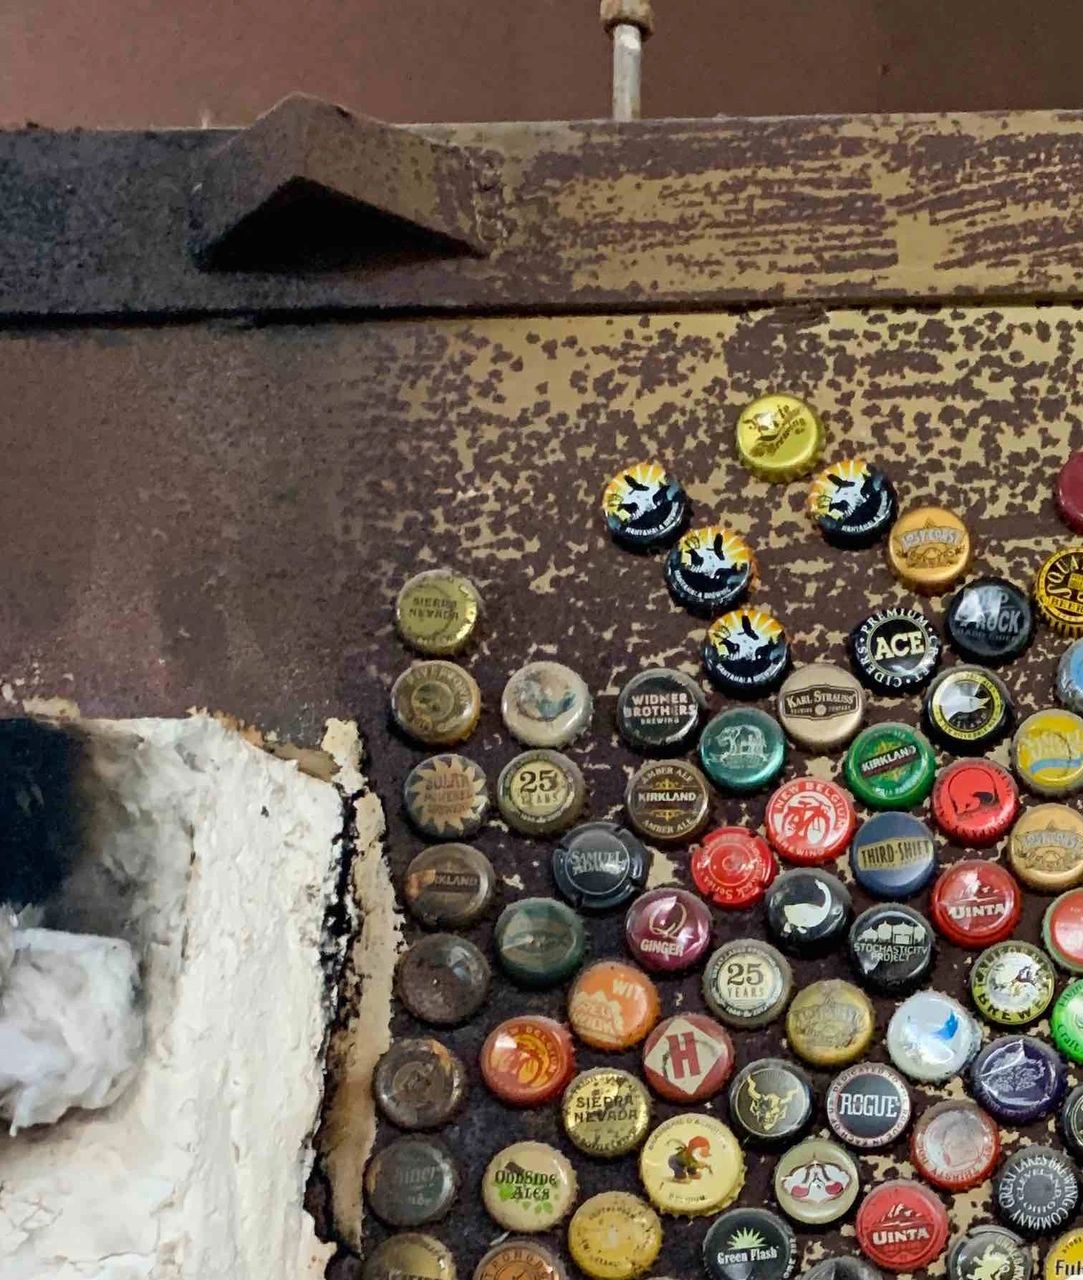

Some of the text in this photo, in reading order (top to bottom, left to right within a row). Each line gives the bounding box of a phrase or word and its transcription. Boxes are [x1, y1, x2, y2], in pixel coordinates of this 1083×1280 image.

[856, 608, 929, 688] PREMIUM CIDERS
[874, 630, 925, 662] ACE
[631, 692, 689, 705] WIDMER
[787, 690, 856, 707] KARL STRAUSS
[623, 703, 697, 718] BROTHERS
[640, 716, 681, 725] BREWING
[860, 745, 917, 773] KIRKLAND
[519, 770, 560, 794] 25
[641, 766, 695, 784] AMBER ALE
[638, 791, 697, 802] KIRKLAND
[775, 781, 848, 831] NEW BELGIUM
[642, 819, 674, 834] AMBER
[571, 851, 622, 866] SAMUEL
[949, 903, 1007, 920] UINTA
[640, 939, 684, 957] GINGER
[854, 942, 929, 957] STOCHASTICITY
[870, 951, 911, 964] PROJECT
[727, 962, 763, 986] 25
[612, 979, 644, 998] WIT
[727, 986, 764, 998] YEARS
[666, 1032, 702, 1080] H
[575, 1095, 635, 1109] SIERRA
[840, 1093, 898, 1117] ROGUE
[574, 1108, 639, 1124] NEVADA
[1015, 1156, 1048, 1174] LAKES
[1010, 1203, 1069, 1231] COMPANY
[872, 1226, 930, 1246] UINTA
[717, 1247, 778, 1265] Green Flash
